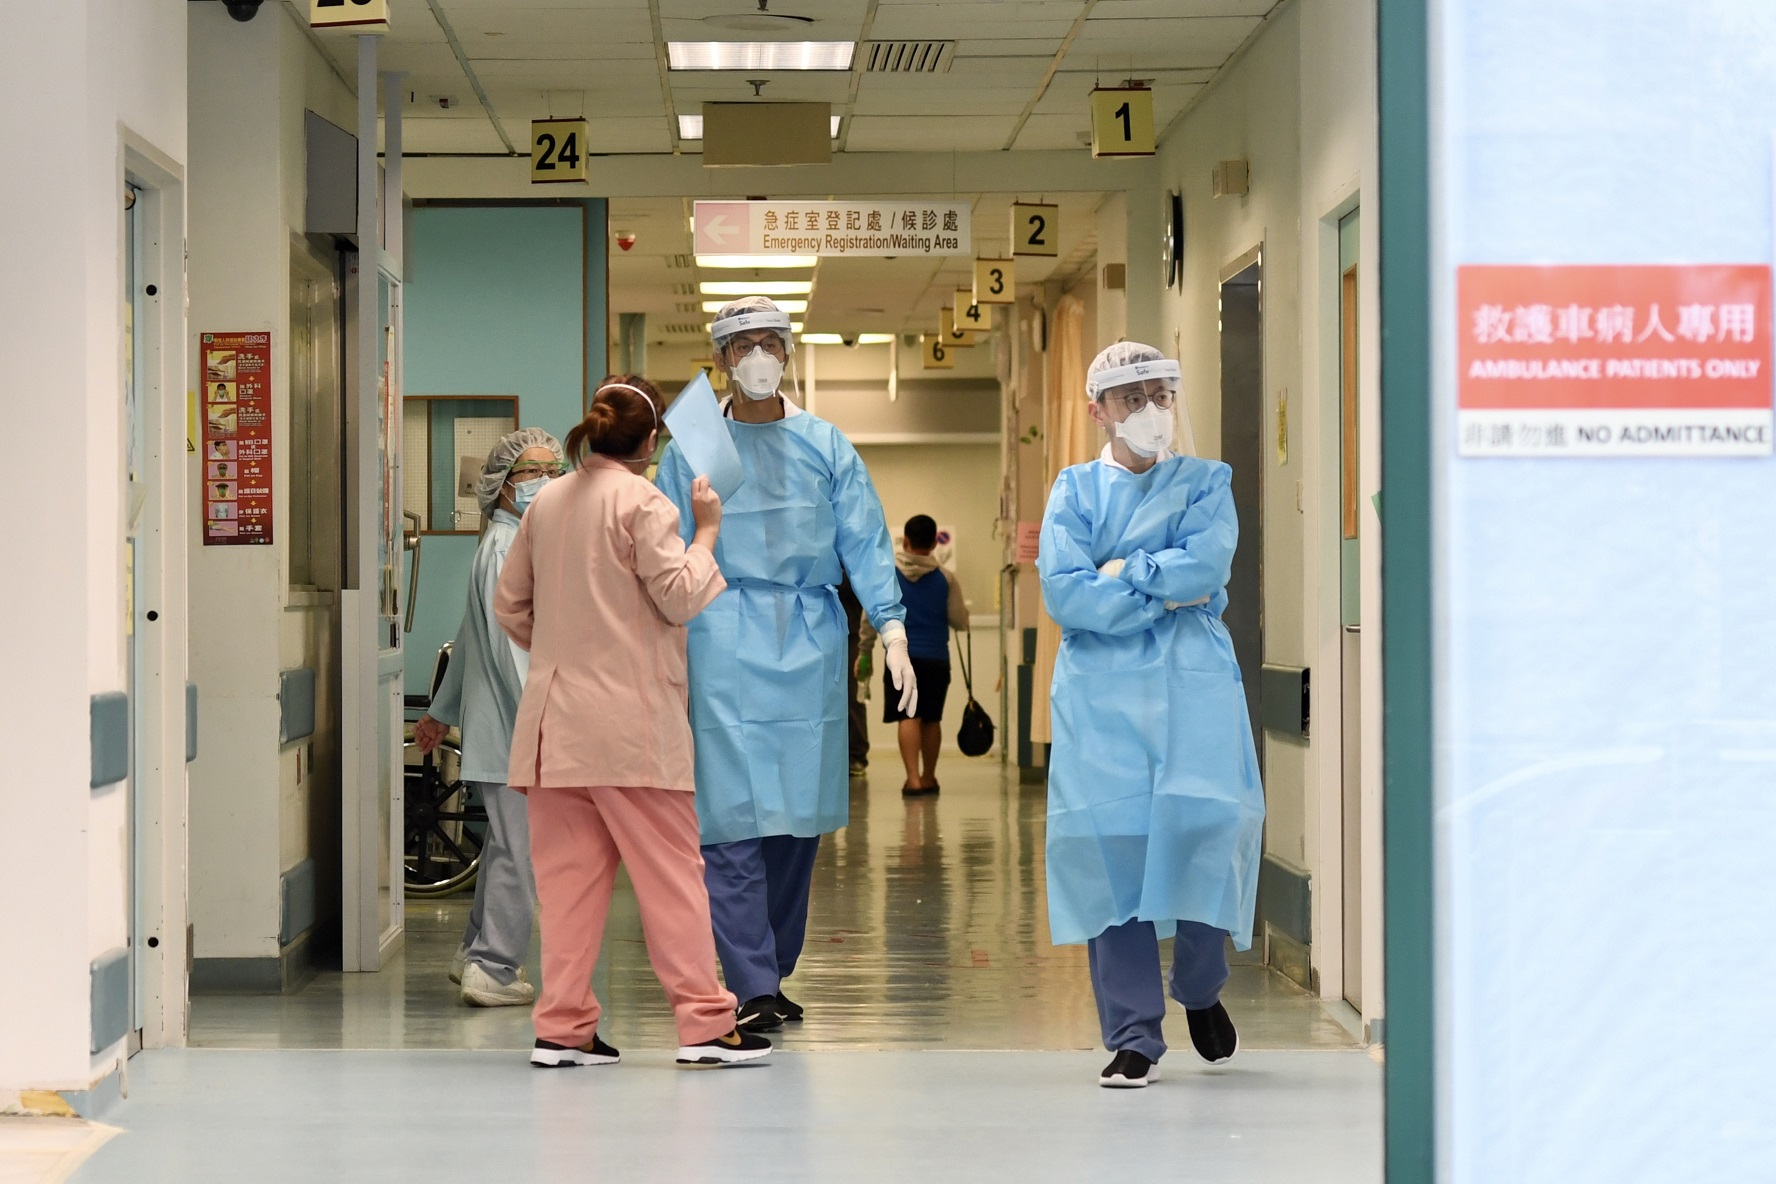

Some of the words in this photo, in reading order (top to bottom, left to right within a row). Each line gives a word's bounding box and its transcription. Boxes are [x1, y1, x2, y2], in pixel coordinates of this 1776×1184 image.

[1115, 102, 1131, 141] 1
[535, 132, 580, 171] 24
[1027, 215, 1045, 245] 2
[763, 234, 822, 253] Emergency
[933, 234, 958, 249] Area
[989, 268, 1004, 295] 3
[966, 304, 981, 323] 4
[1472, 303, 1755, 344] 救護車病人專用
[932, 341, 945, 361] 6
[1468, 358, 1601, 379] AMBULANCE
[1605, 358, 1701, 379] PATIENTS
[1705, 358, 1761, 379] ONLY
[1465, 424, 1569, 447] 非請勿進
[1577, 425, 1612, 445] NO
[1619, 424, 1767, 445] ADMITTANCE
